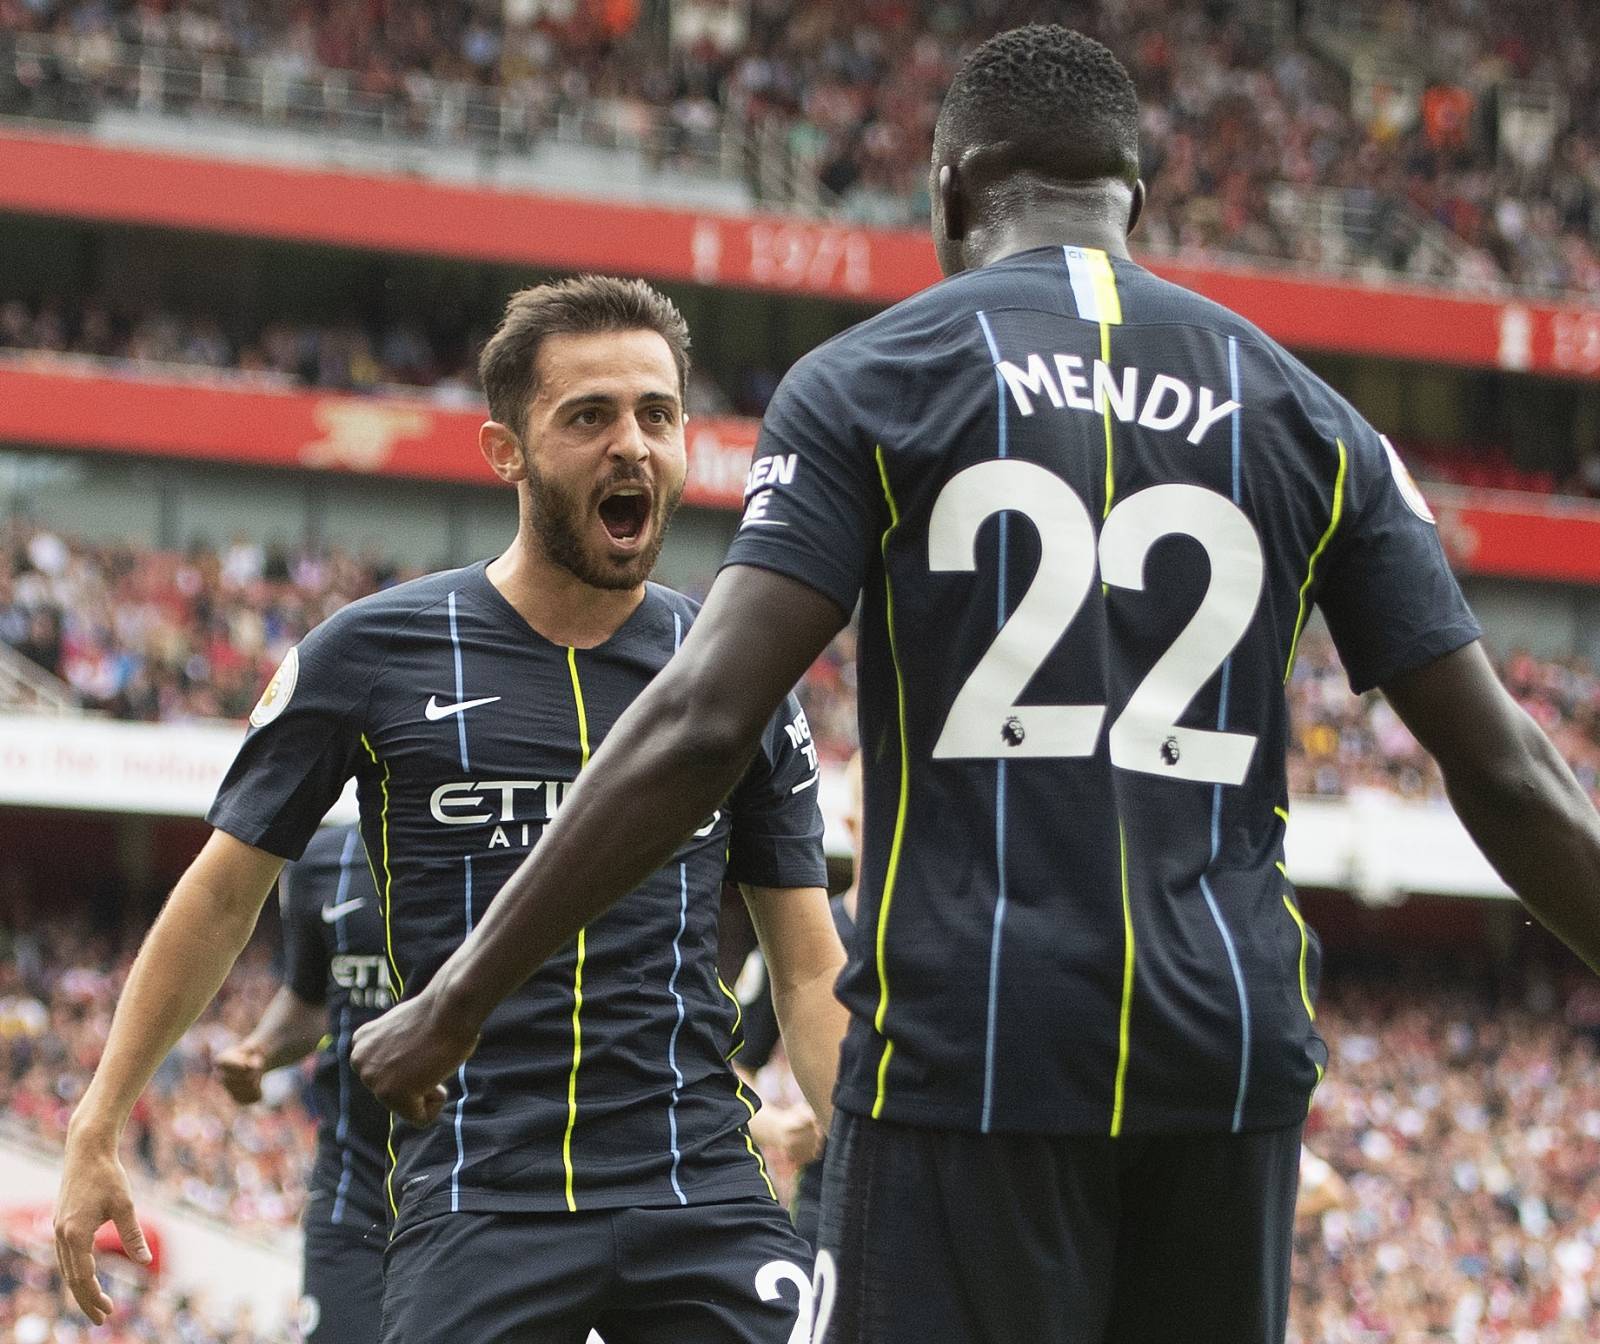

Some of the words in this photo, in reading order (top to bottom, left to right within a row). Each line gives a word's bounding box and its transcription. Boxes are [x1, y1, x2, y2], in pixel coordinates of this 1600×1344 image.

[994, 353, 1241, 445] MENDY
[928, 458, 1264, 786] 22
[488, 824, 550, 849] AI
